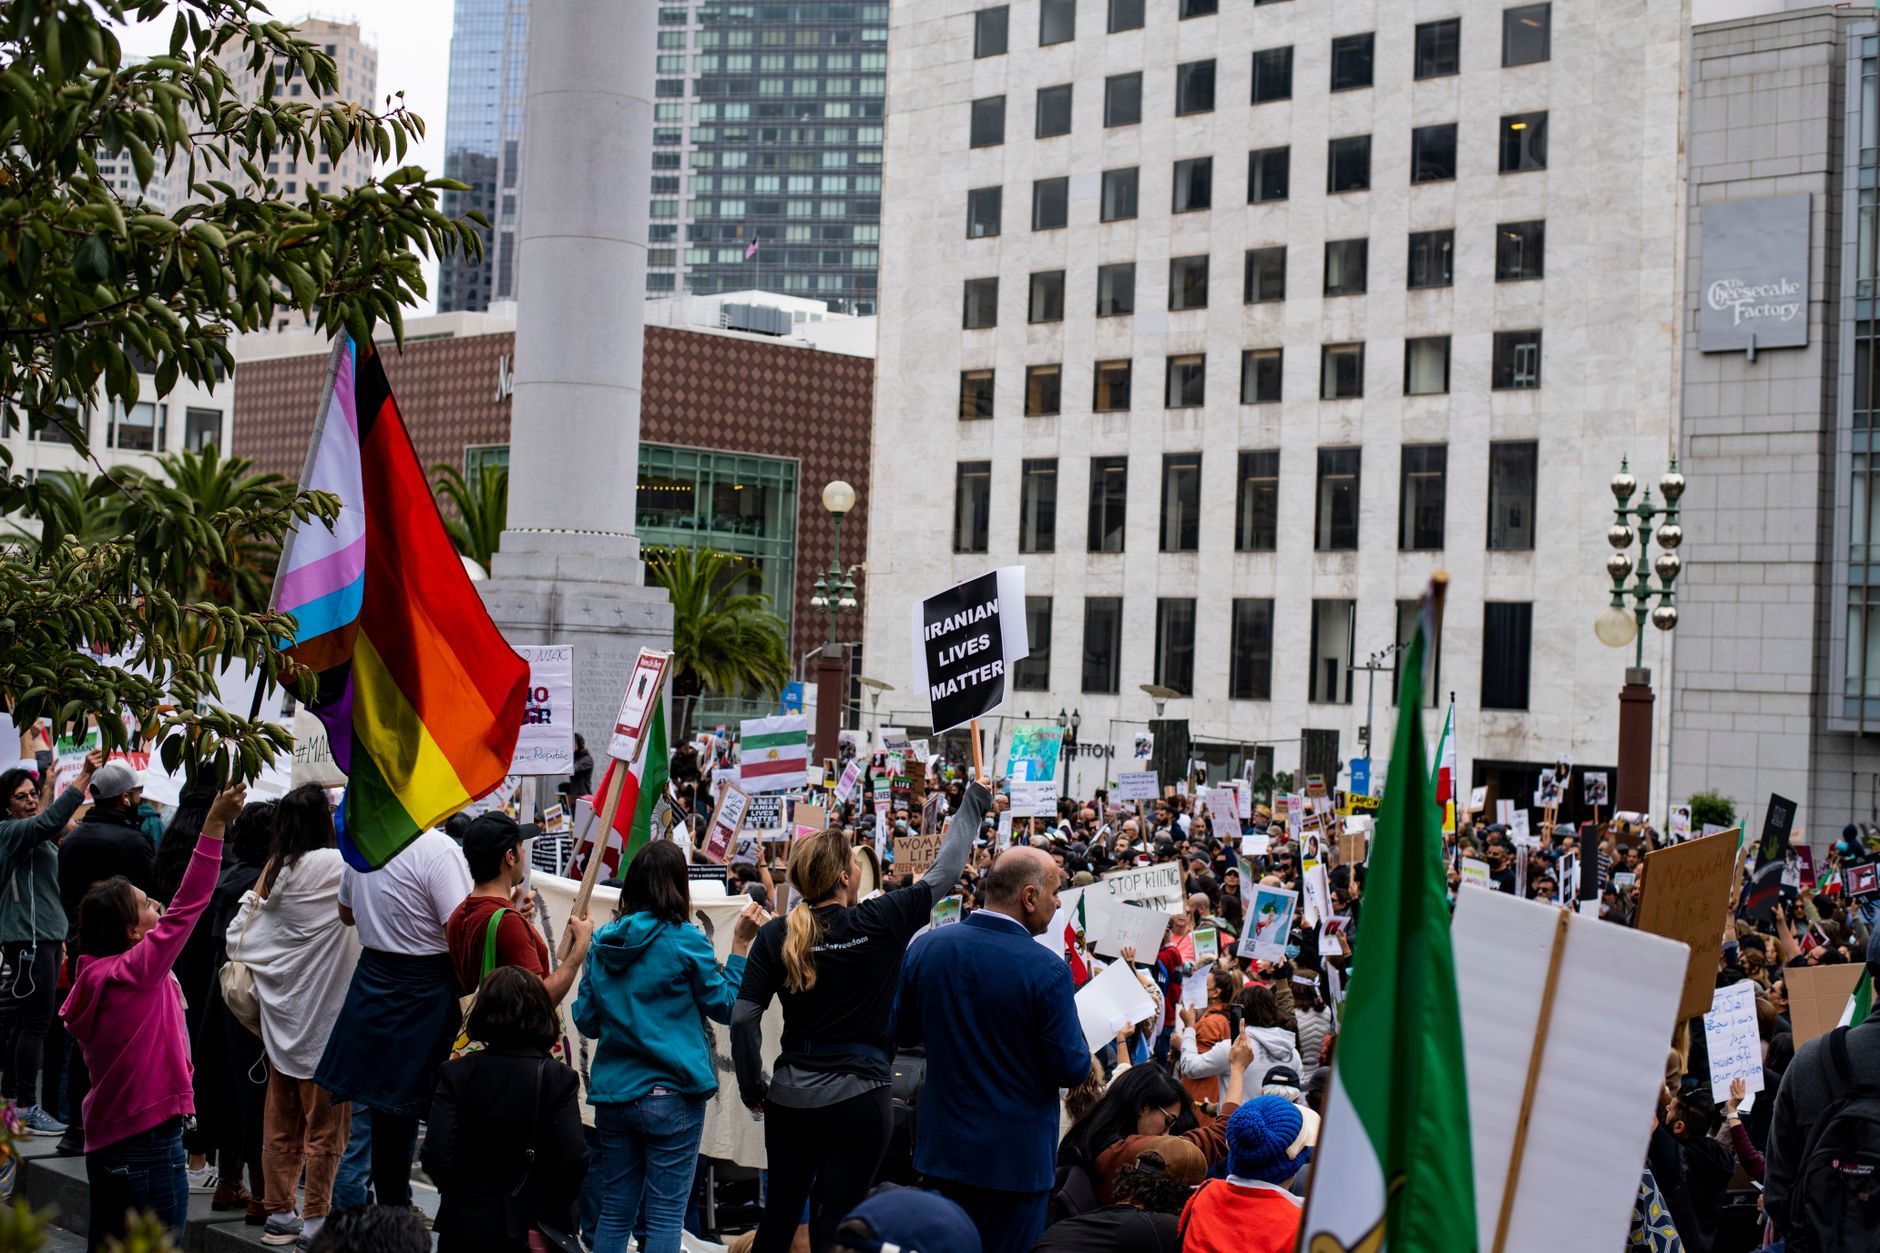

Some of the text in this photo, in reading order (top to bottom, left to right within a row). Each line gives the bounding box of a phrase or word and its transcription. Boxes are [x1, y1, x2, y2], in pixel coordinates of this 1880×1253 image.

[1707, 277, 1800, 311] Cheesecake
[1729, 298, 1800, 328] Factory
[924, 597, 999, 642] IRANIAN
[938, 633, 991, 668] LIVES
[930, 659, 1005, 702] MATTER
[874, 790, 890, 800] LIVES
[894, 780, 911, 789] LIFE
[897, 838, 941, 851] WOMA
[1108, 874, 1141, 895] STOP
